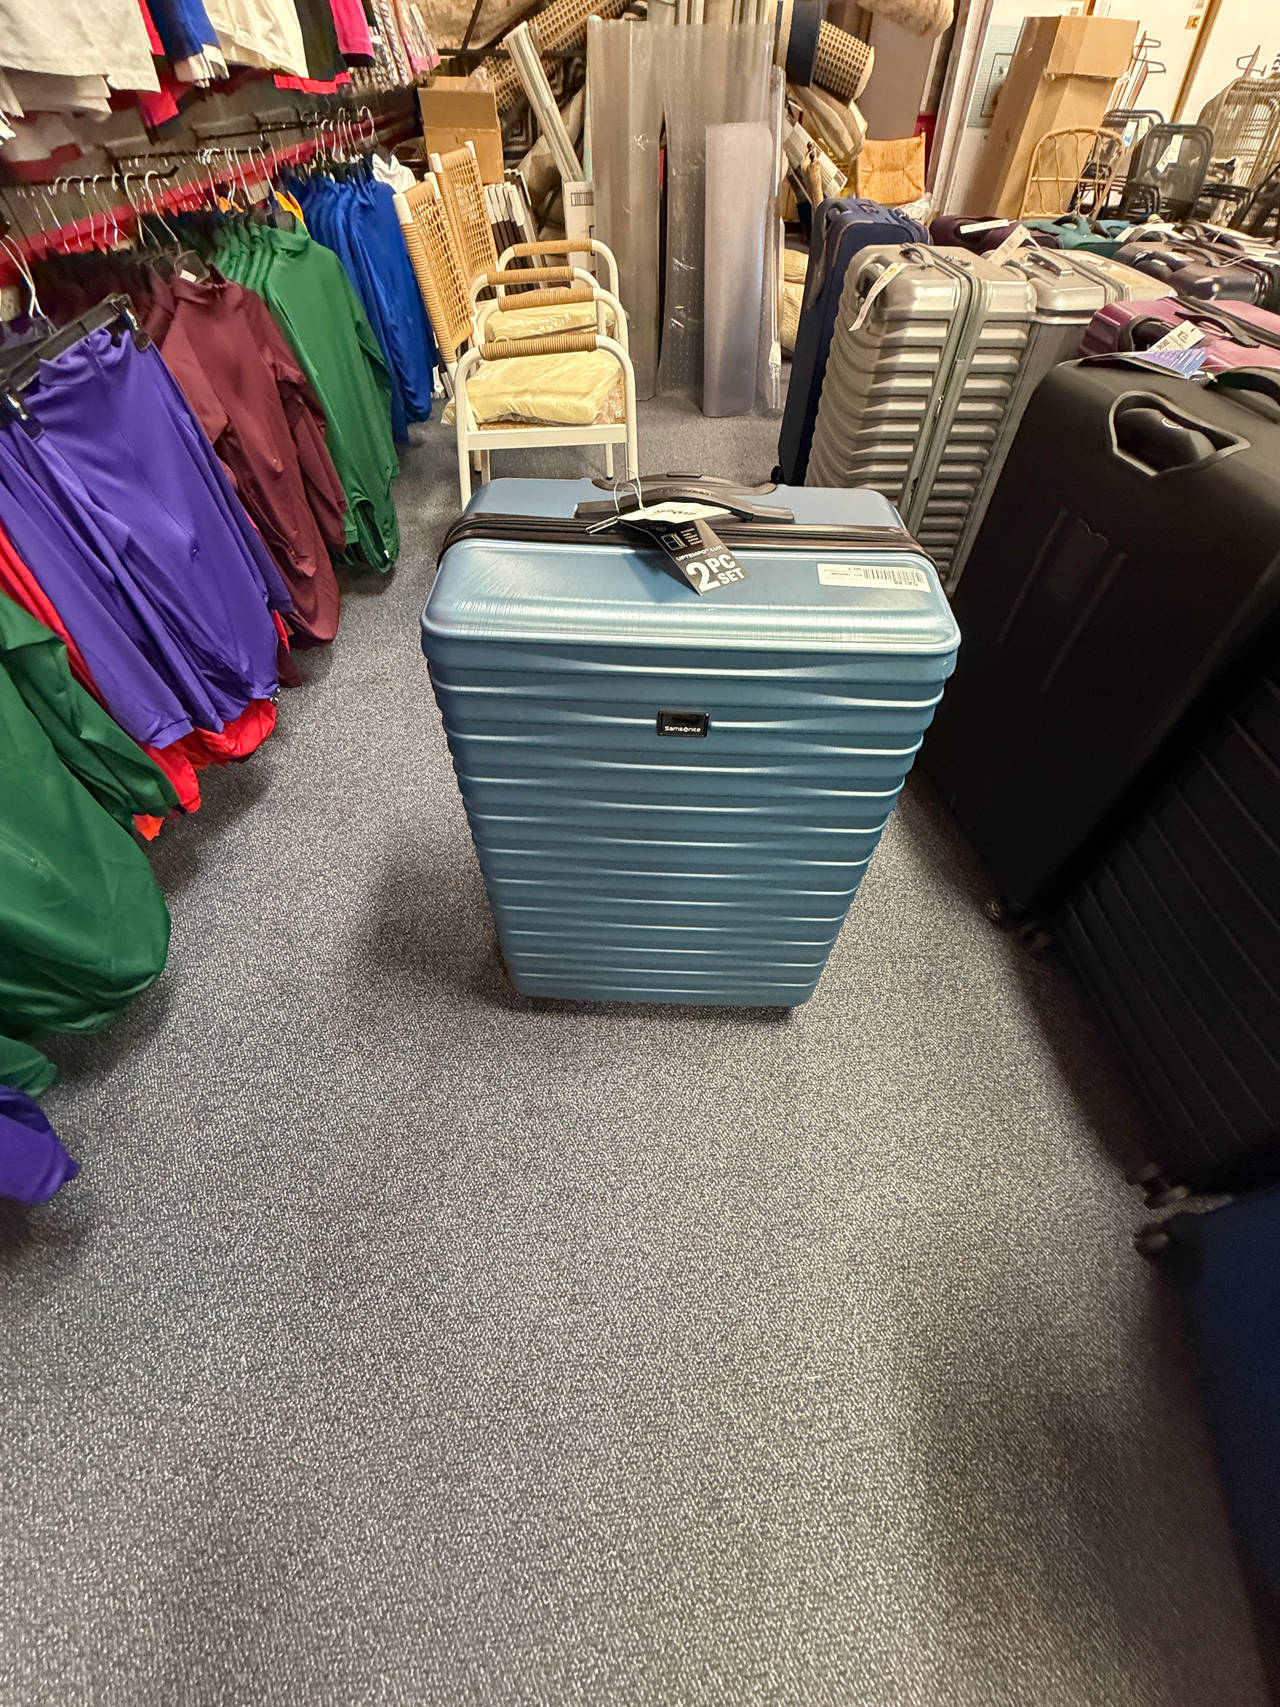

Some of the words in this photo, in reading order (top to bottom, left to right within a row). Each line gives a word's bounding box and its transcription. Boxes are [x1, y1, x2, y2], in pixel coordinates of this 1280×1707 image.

[704, 554, 736, 573] PC
[685, 561, 721, 592] 2
[717, 567, 745, 584] SET
